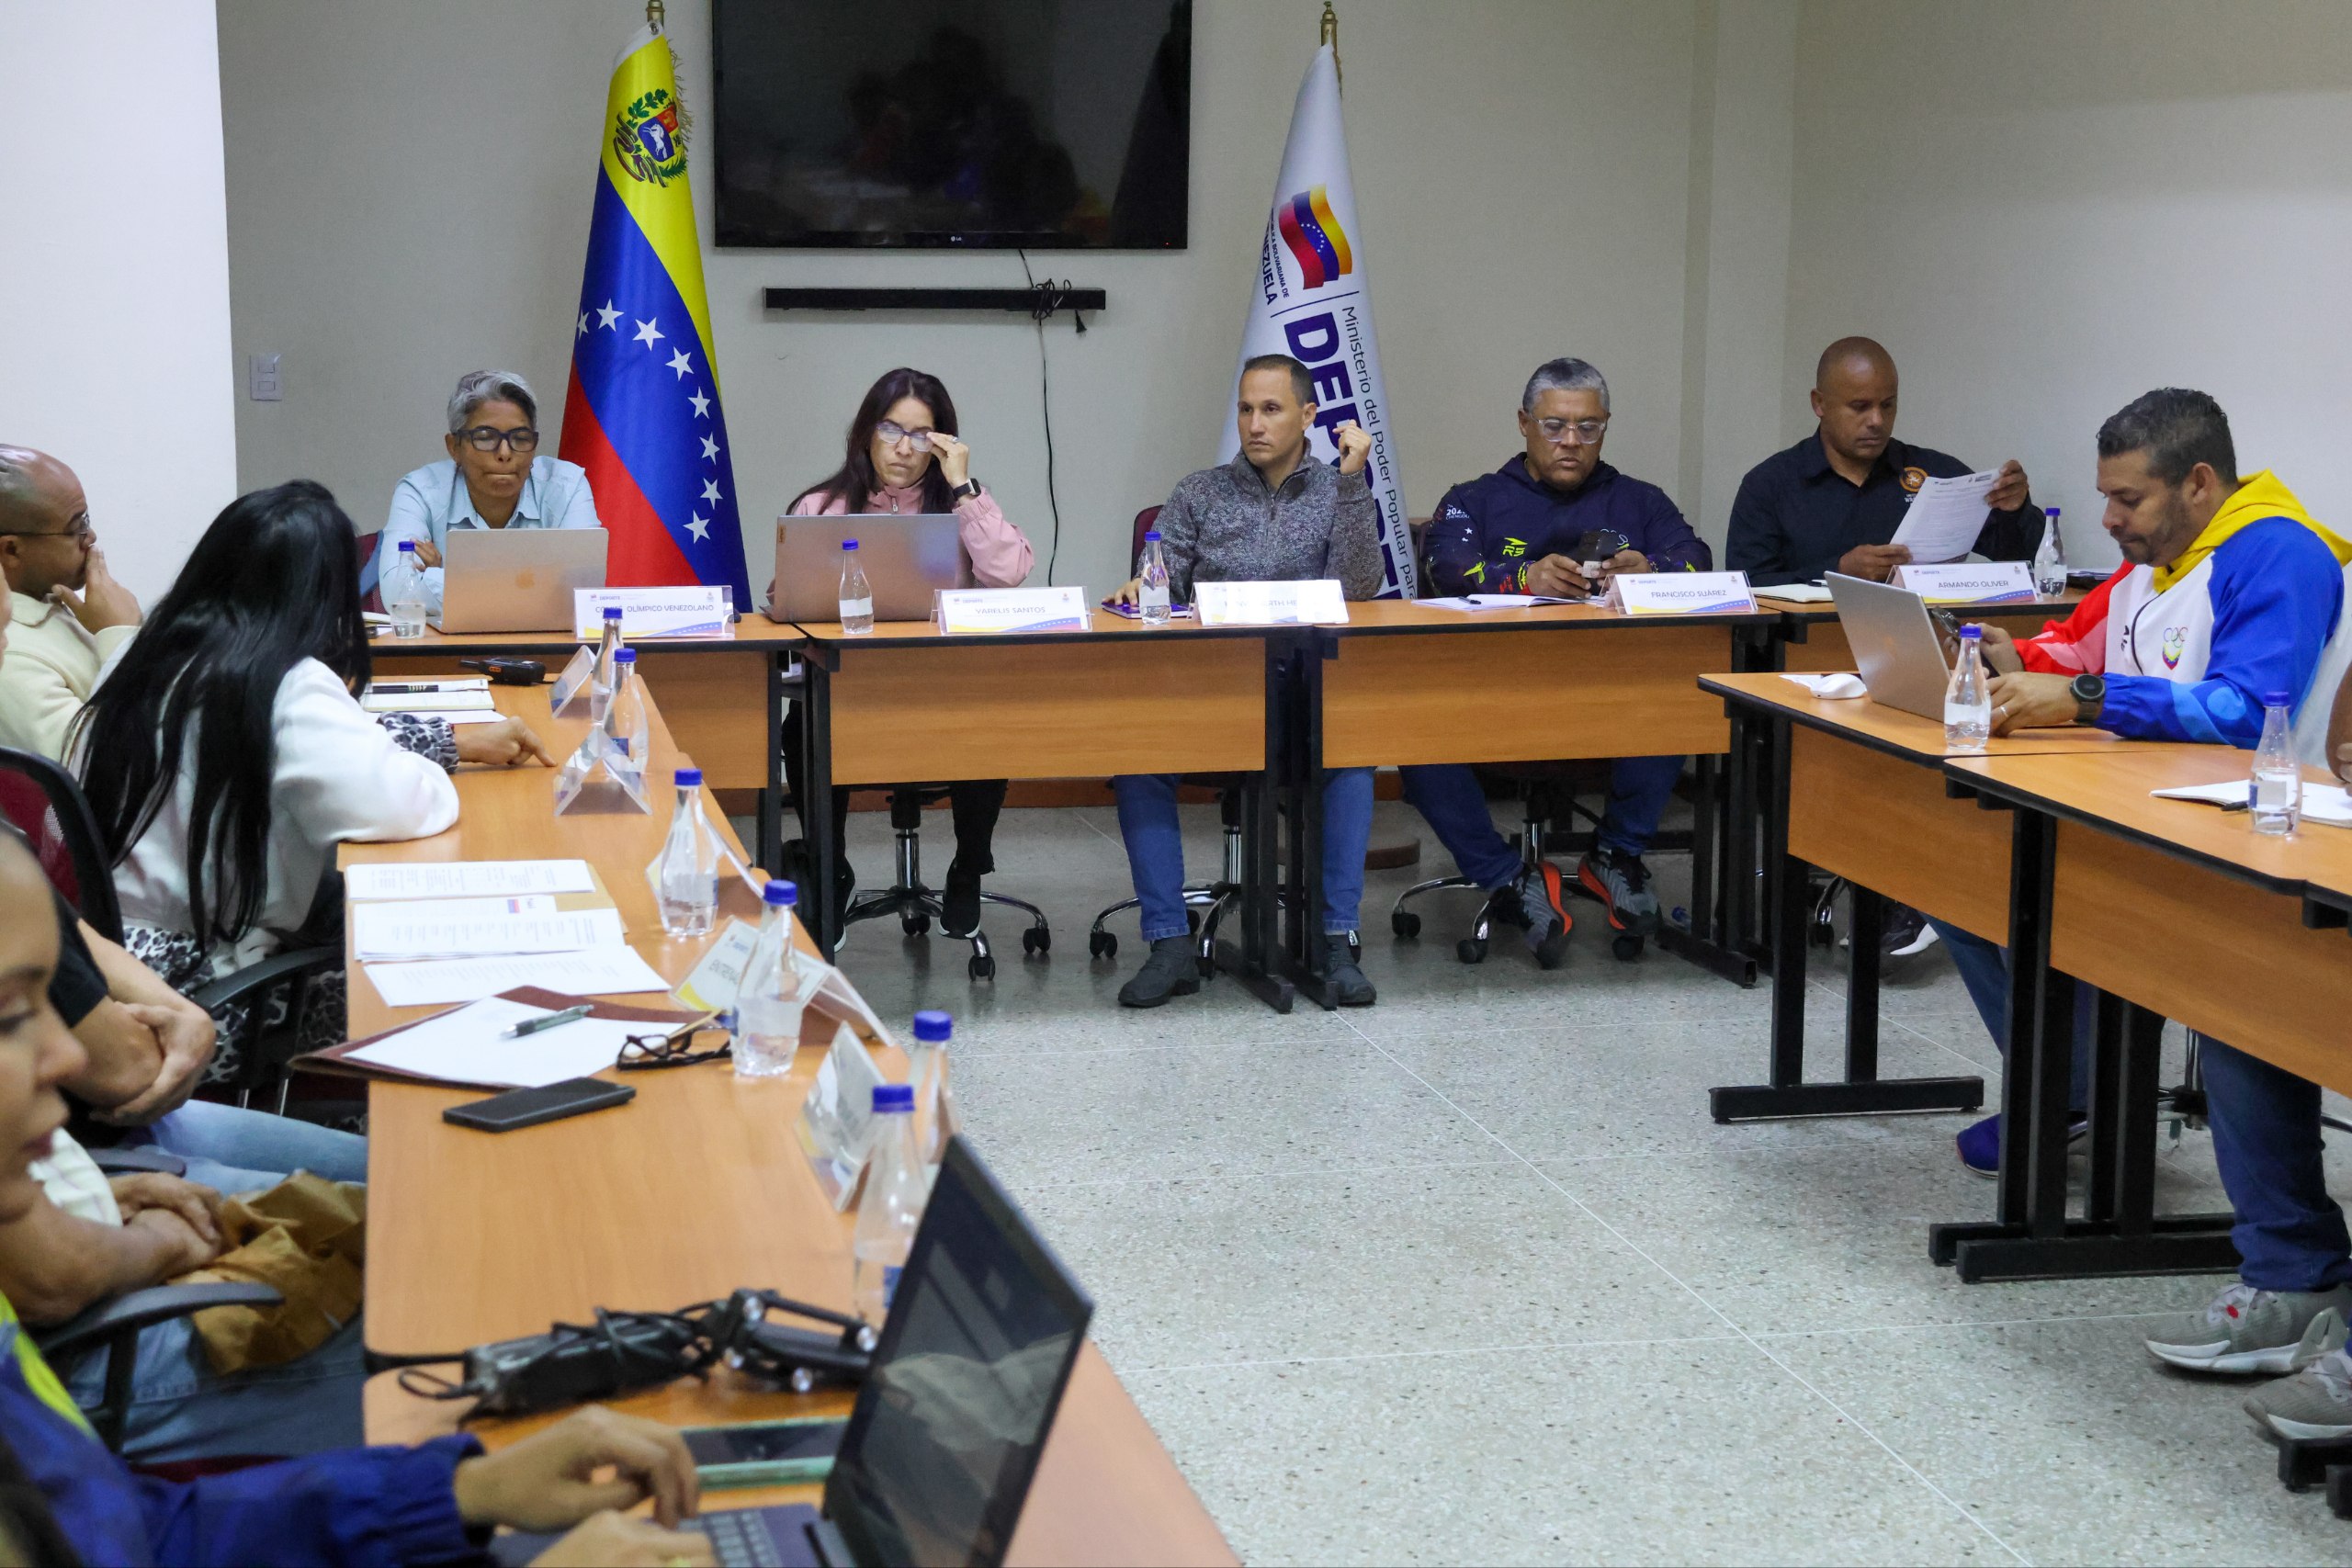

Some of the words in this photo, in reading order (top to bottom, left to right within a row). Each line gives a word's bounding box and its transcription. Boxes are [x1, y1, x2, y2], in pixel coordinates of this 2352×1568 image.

[1272, 243, 1286, 288] BOLIVARIANA
[1282, 288, 1290, 299] DE
[1342, 306, 1371, 394] Ministerio
[1363, 395, 1380, 428] del
[1372, 430, 1392, 485] Poder
[1385, 489, 1408, 558] Popular
[1981, 580, 2009, 588] OLIVER
[627, 604, 662, 613] OLÍMPICO
